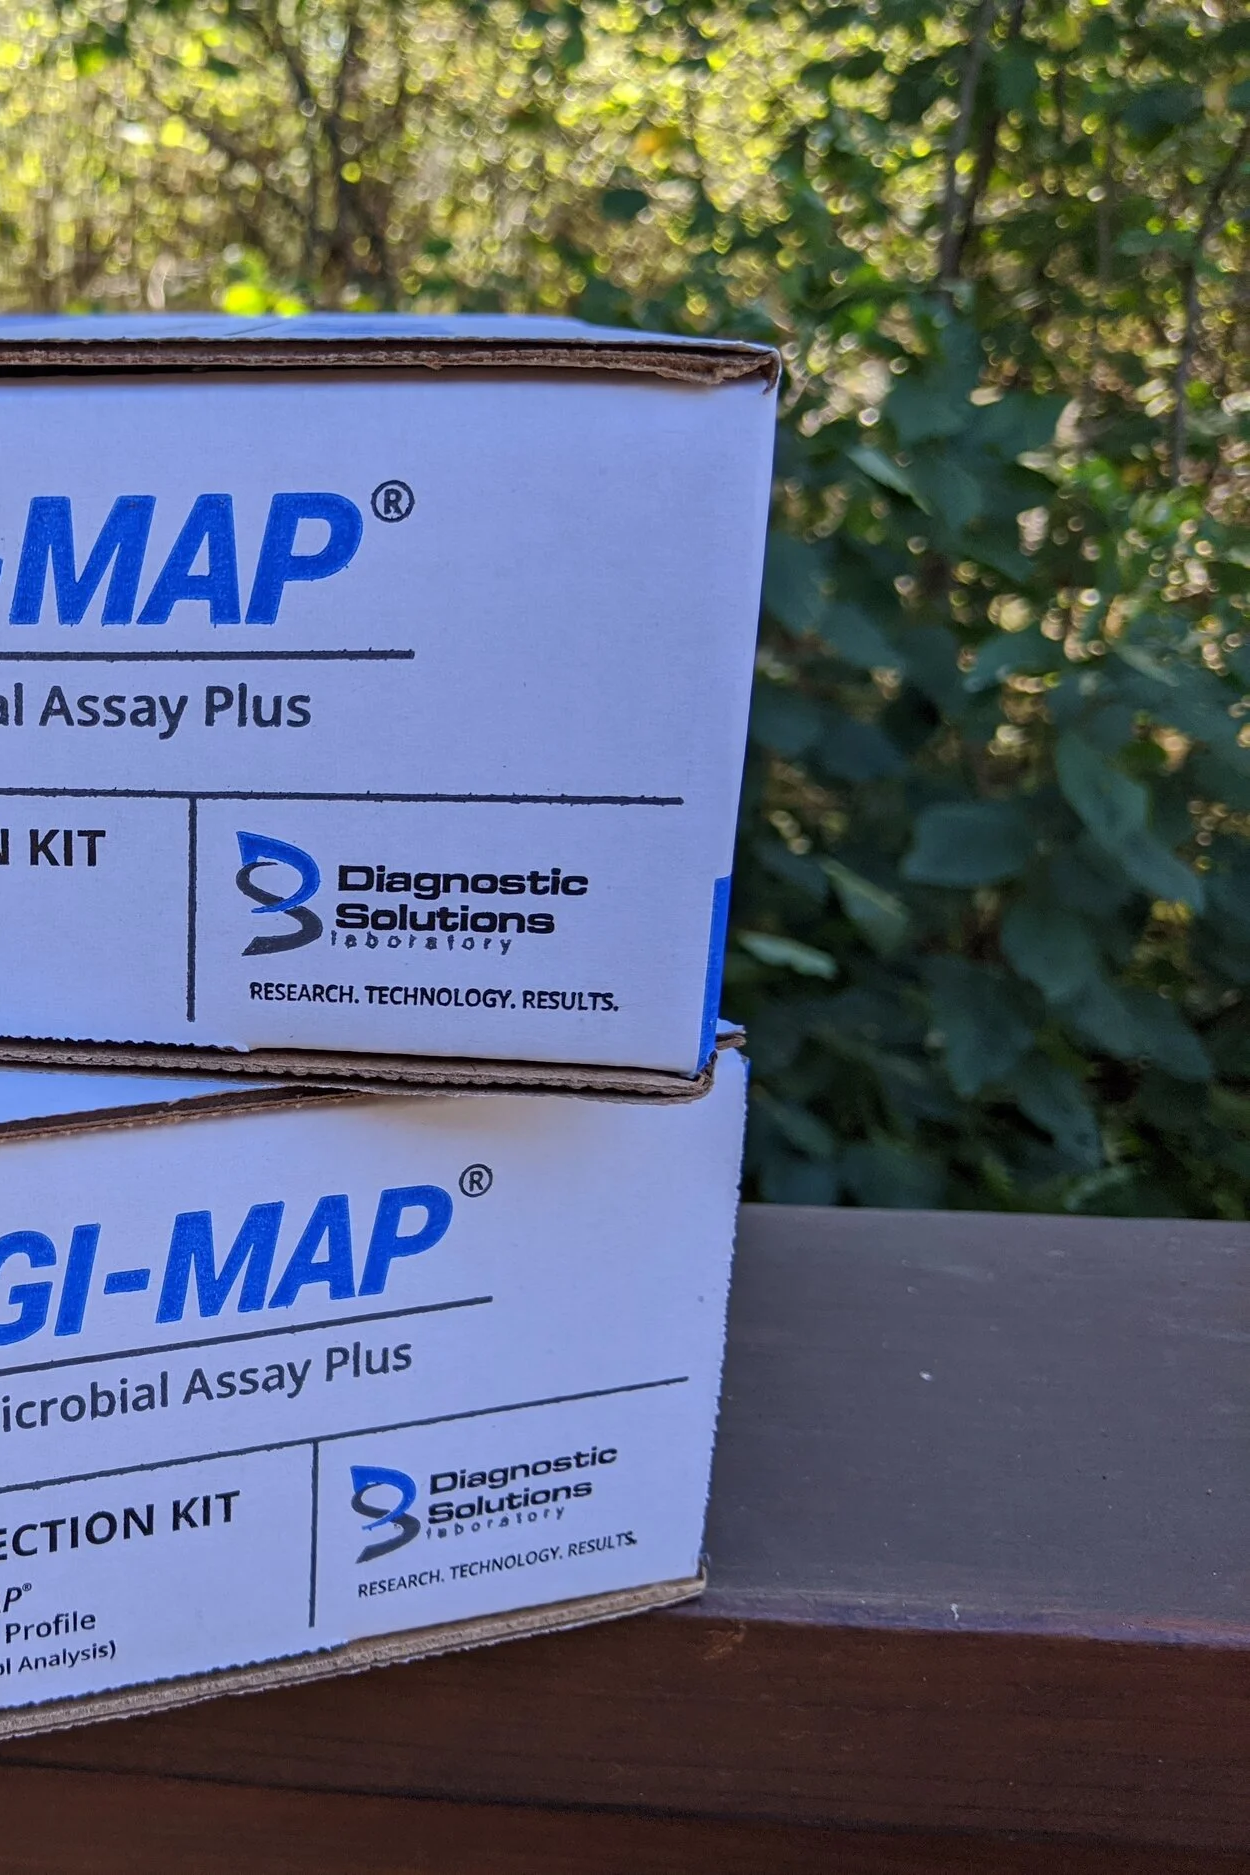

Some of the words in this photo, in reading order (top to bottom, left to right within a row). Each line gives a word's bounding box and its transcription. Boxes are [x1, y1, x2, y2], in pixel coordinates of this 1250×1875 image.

[39, 686, 188, 740] Assay
[205, 682, 311, 728] Plus
[29, 829, 106, 867] KIT
[338, 865, 589, 899] Diagnostic
[335, 903, 555, 934] Solutions
[331, 930, 512, 956] laboratory
[250, 982, 359, 1004] RESEARCH.
[364, 986, 516, 1009] TECHNOLOGY.
[522, 990, 619, 1012] RESULTS.
[182, 1359, 311, 1404] Assay
[326, 1342, 411, 1382] Plus
[430, 1446, 618, 1495] Diagnostic
[172, 1490, 240, 1531] KIT
[428, 1481, 593, 1525] Solutions
[426, 1506, 565, 1540] laboratory
[358, 1569, 444, 1597] RESEARCH.
[450, 1546, 562, 1579] TECHNOLOGY.
[568, 1531, 637, 1557] RESULTS.
[6, 1611, 97, 1645] Profile
[18, 1640, 116, 1672] Analysis)
